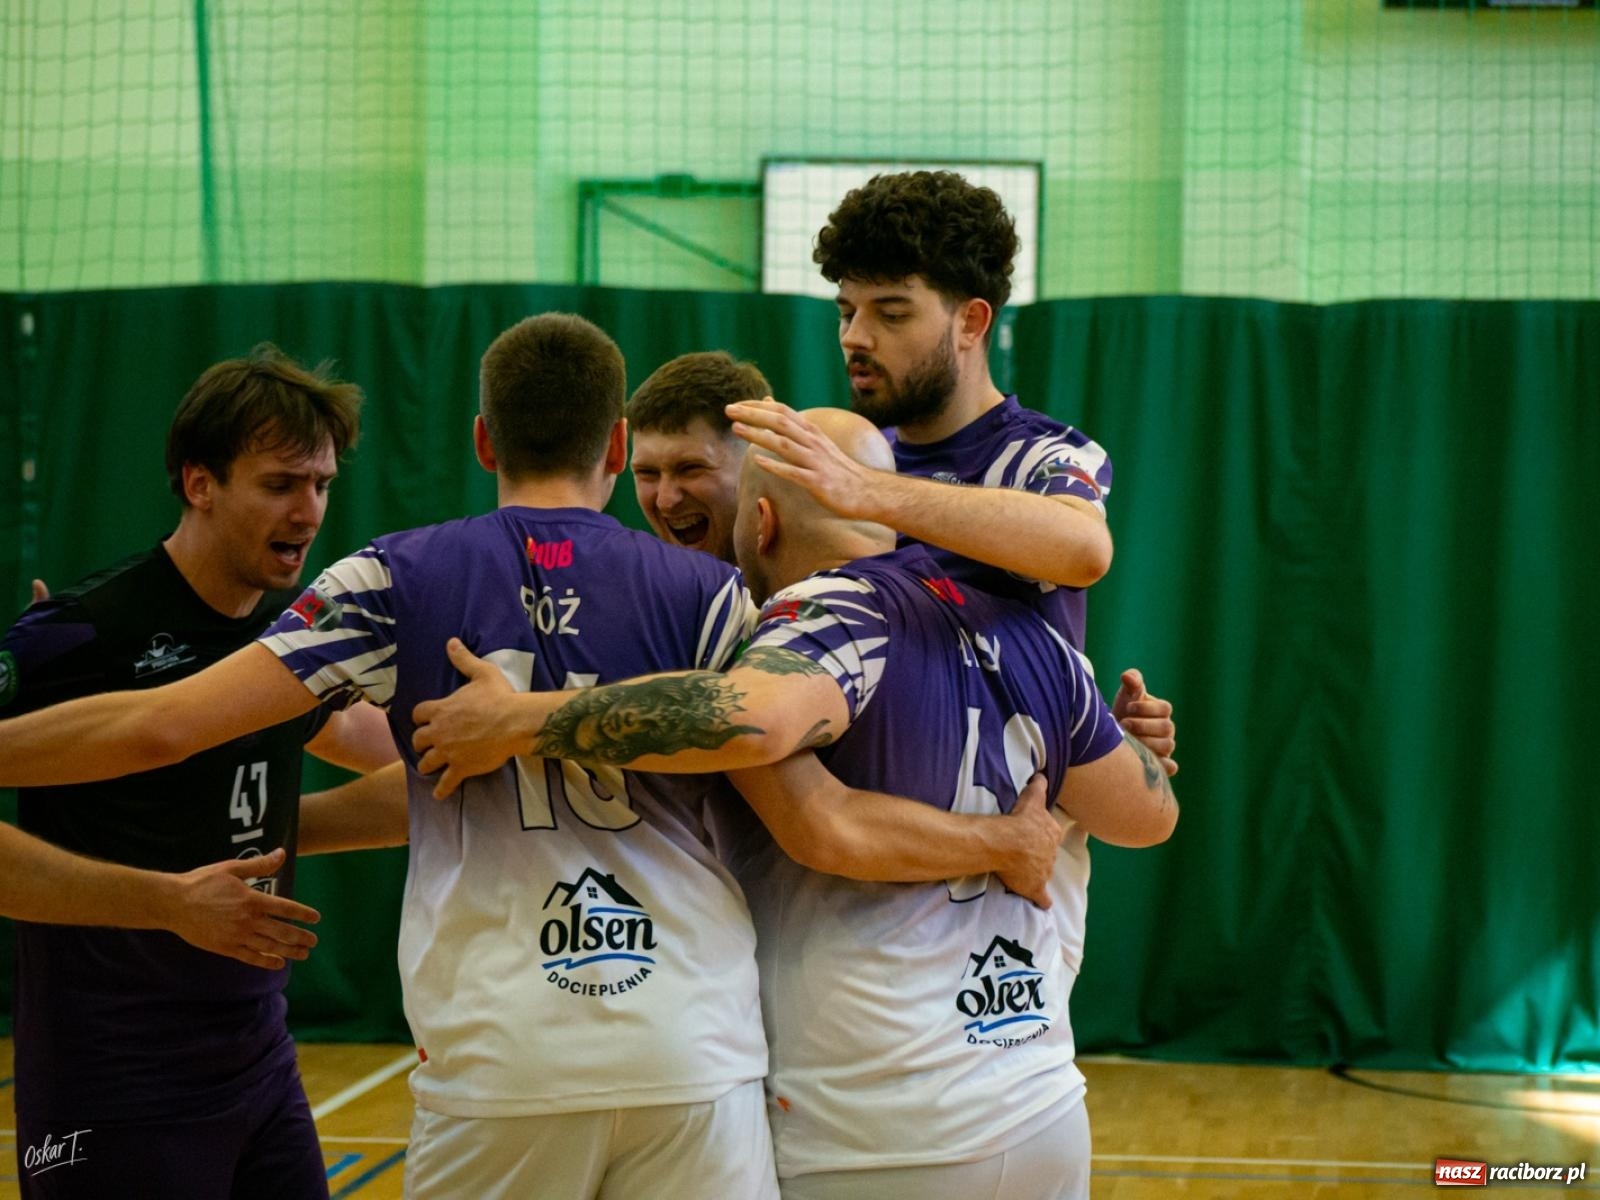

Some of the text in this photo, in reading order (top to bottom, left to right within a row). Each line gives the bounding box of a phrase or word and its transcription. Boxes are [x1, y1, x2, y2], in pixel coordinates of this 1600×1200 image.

[229, 761, 268, 827] 47
[540, 903, 658, 955] olsen
[546, 967, 652, 996] DOCIEPLENIA
